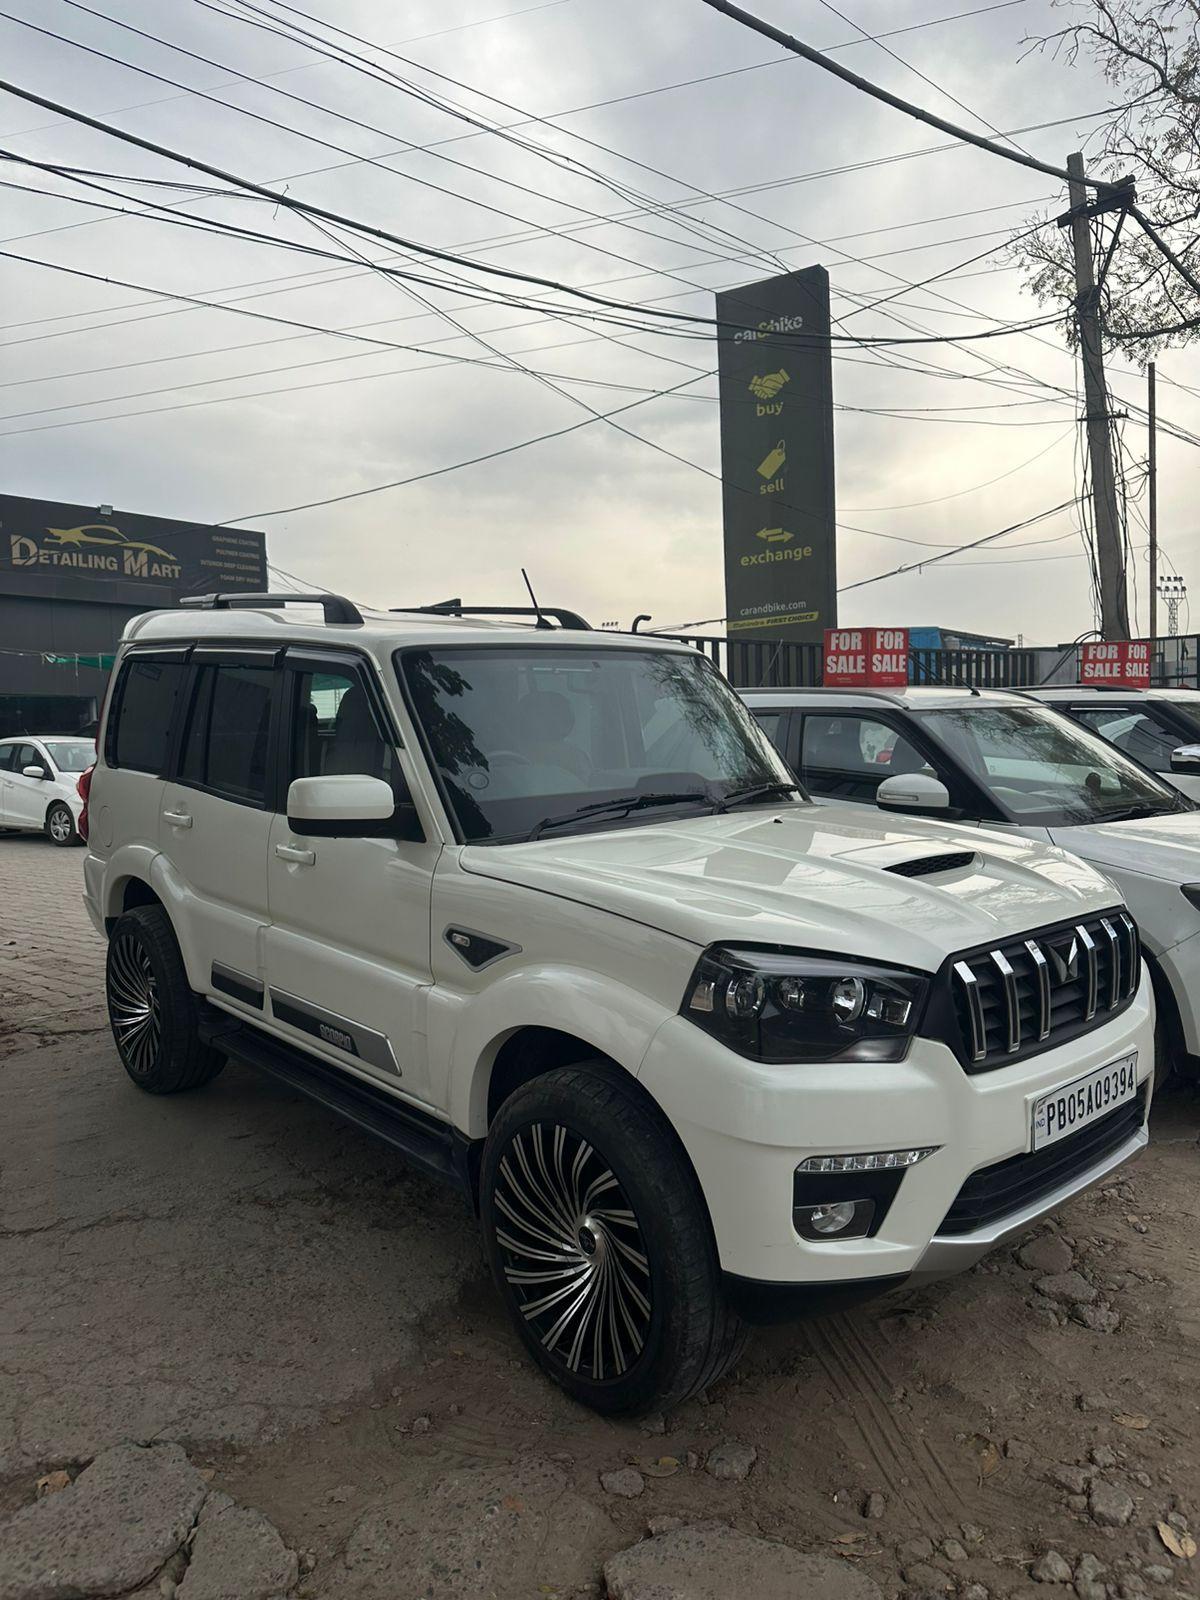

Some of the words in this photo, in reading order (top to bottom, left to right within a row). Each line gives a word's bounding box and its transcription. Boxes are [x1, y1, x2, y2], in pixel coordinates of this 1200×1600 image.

[756, 402, 784, 417] buy
[760, 479, 785, 495] sell
[10, 535, 118, 570] DETAILING
[124, 550, 182, 578] MART
[740, 545, 813, 566] exchange
[740, 600, 807, 616] carandbike.com
[766, 617, 787, 625] FIRST
[830, 632, 862, 651] FOR
[876, 630, 904, 649] FOR
[1088, 644, 1118, 660] FOR
[1128, 643, 1147, 659] FOR
[826, 655, 865, 674] SALE
[872, 653, 906, 673] SALE
[1084, 662, 1121, 677] SALE
[1125, 662, 1149, 677] SALE
[1047, 1062, 1134, 1136] PB05AQ9394
